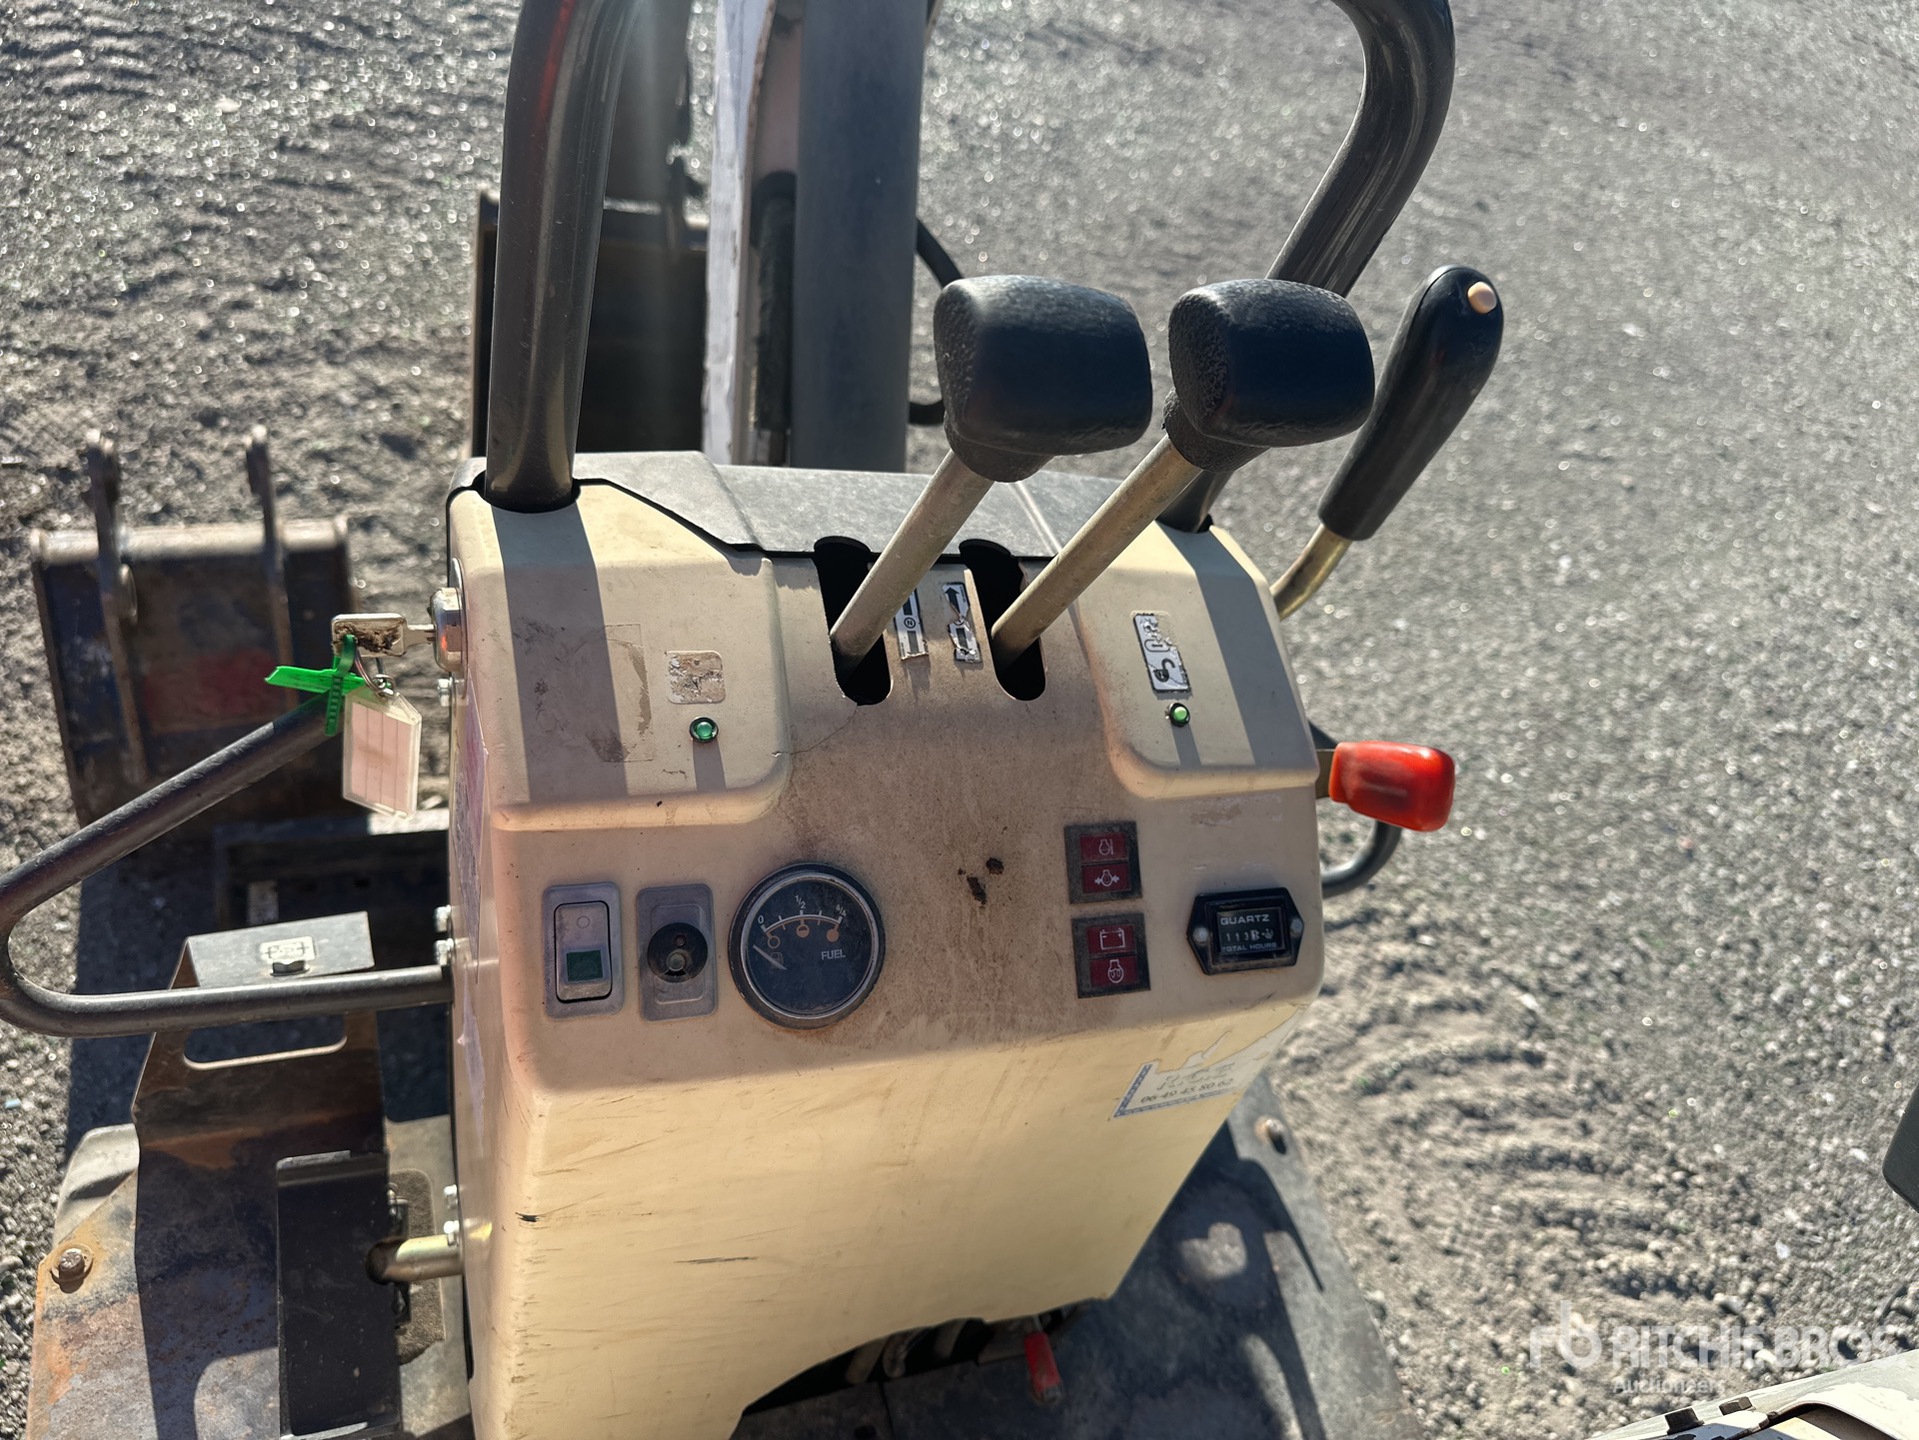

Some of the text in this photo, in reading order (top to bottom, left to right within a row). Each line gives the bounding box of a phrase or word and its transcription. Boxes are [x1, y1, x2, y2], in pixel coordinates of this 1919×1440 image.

[1220, 914, 1270, 925] QUARTZ
[1221, 942, 1277, 953] TOTAL HOURS
[821, 949, 846, 960] FUEL
